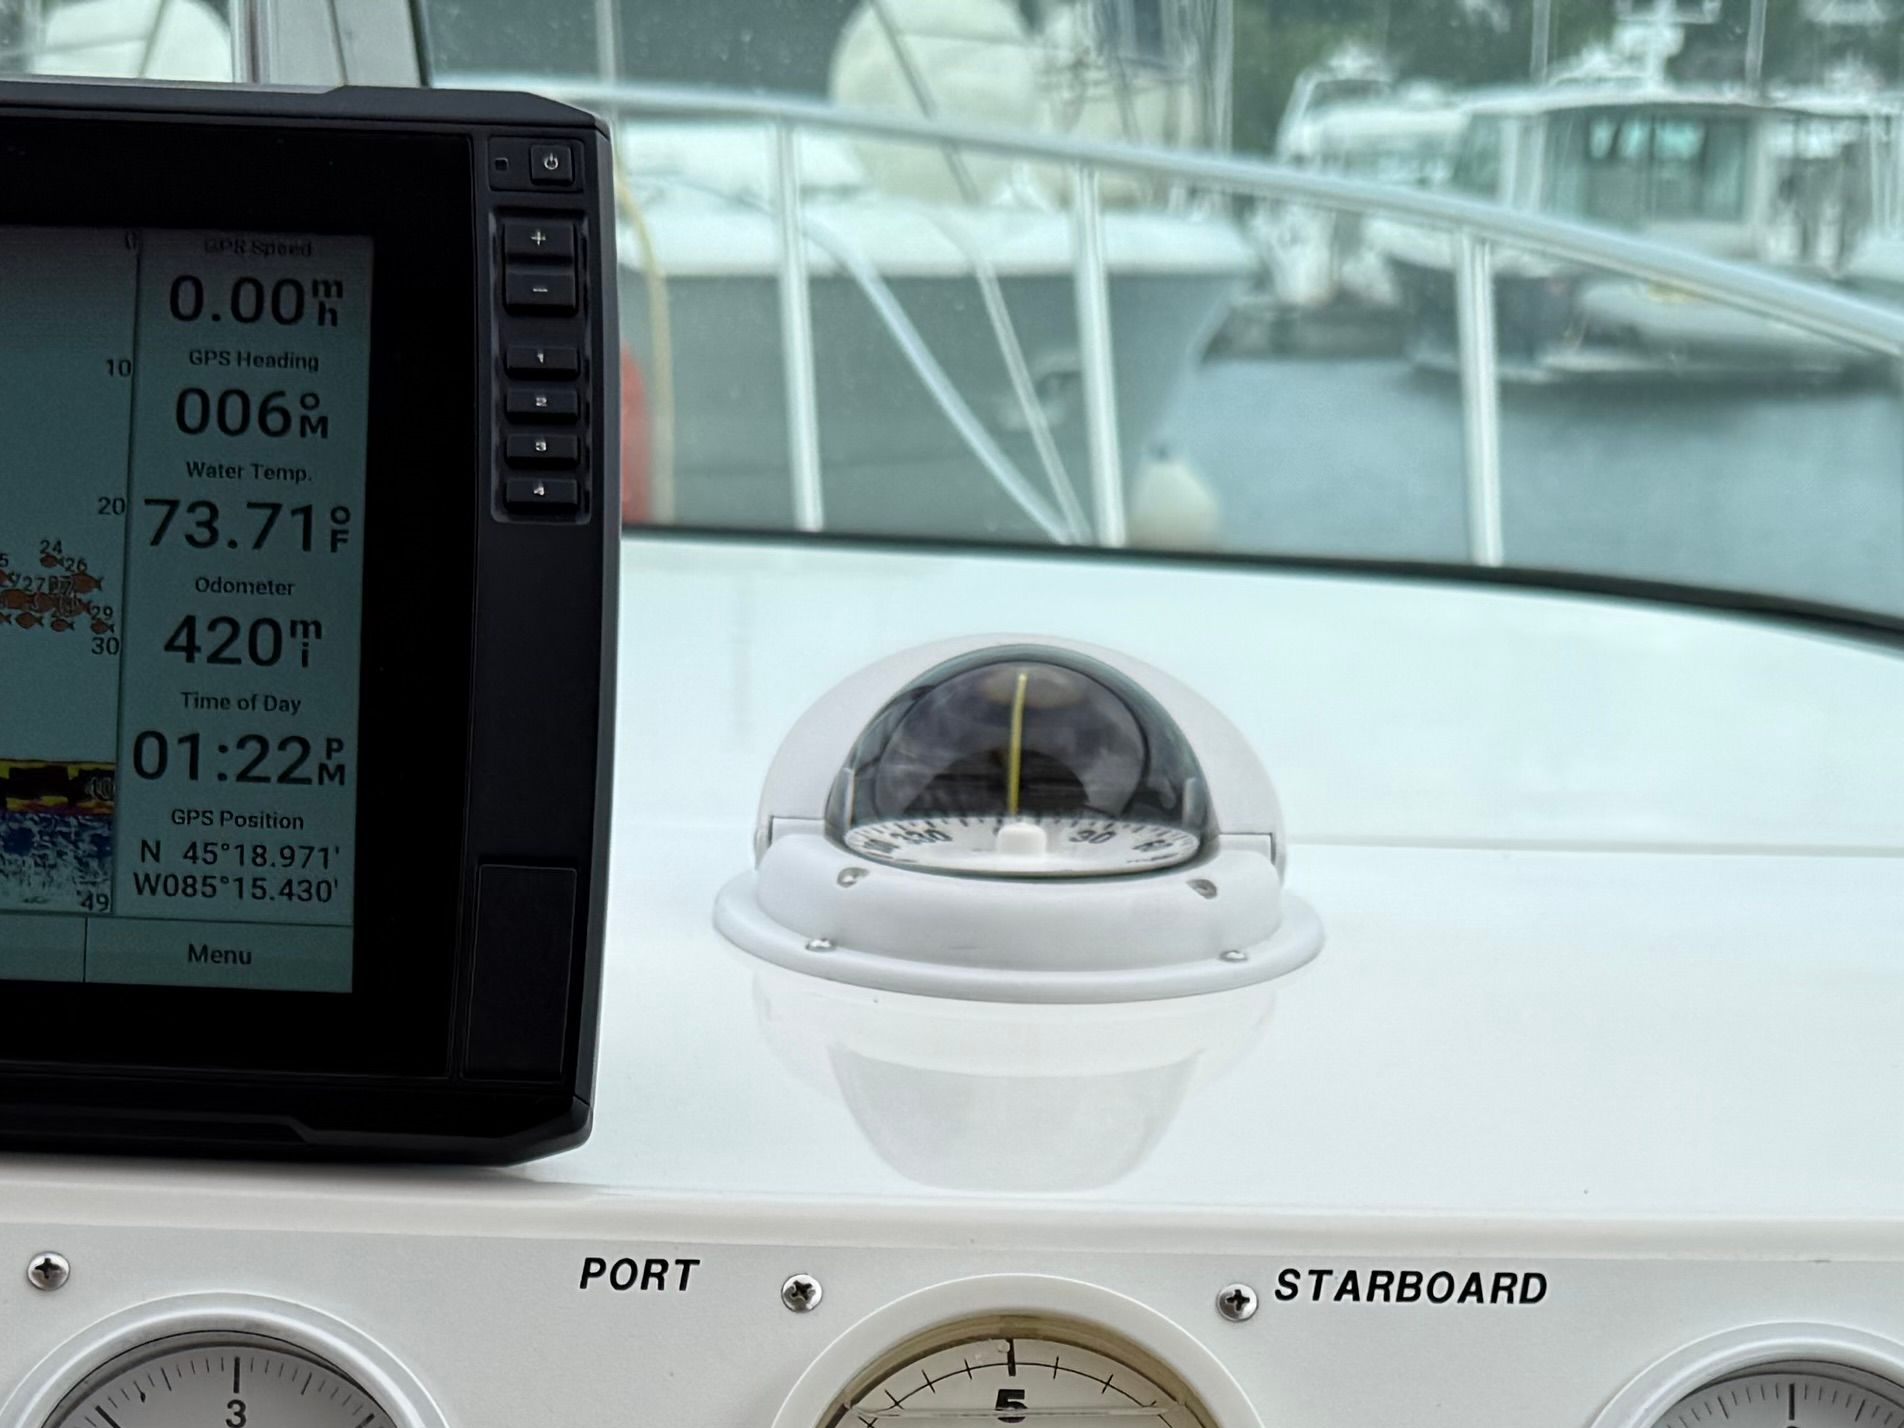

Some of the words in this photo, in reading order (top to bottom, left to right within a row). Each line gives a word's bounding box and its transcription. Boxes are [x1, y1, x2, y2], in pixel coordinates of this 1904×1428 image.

[189, 350, 231, 369] GPS
[236, 351, 319, 375] Heading
[186, 460, 245, 482] Water
[250, 463, 312, 486] Temp.
[195, 576, 295, 597] Odometer
[91, 637, 120, 656] 30
[181, 691, 231, 712] Time
[236, 692, 258, 712] of
[263, 693, 302, 717] Day
[133, 730, 312, 785] 01:22
[171, 810, 214, 830] GPS
[219, 810, 304, 833] Position
[140, 840, 162, 863] N
[188, 943, 253, 968] Menu
[578, 1256, 701, 1292] PORT
[1273, 1267, 1548, 1306] STARBOARD
